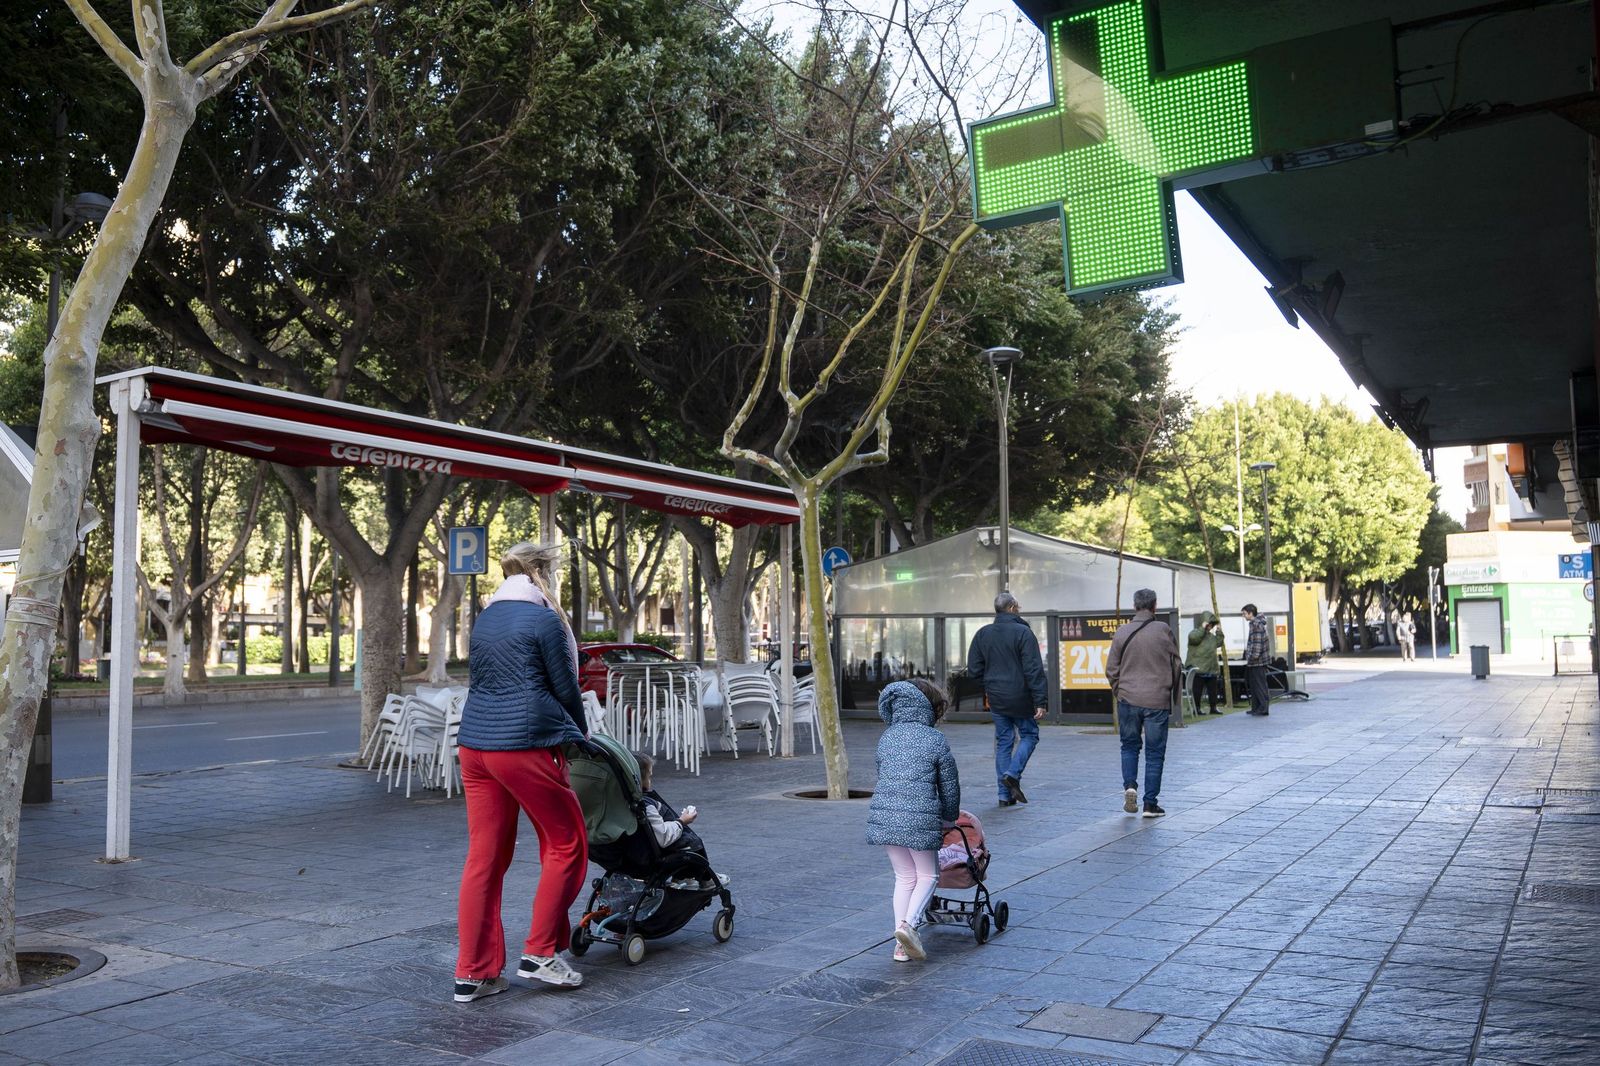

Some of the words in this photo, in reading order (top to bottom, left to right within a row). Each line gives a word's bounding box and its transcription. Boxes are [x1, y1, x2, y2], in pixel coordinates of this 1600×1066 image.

[329, 442, 453, 474] telepizza
[663, 495, 733, 514] telepizza
[456, 532, 478, 569] P
[1572, 556, 1584, 569] S
[1563, 570, 1584, 578] ATM
[1461, 584, 1494, 593] Entrada
[1087, 619, 1098, 627] TU
